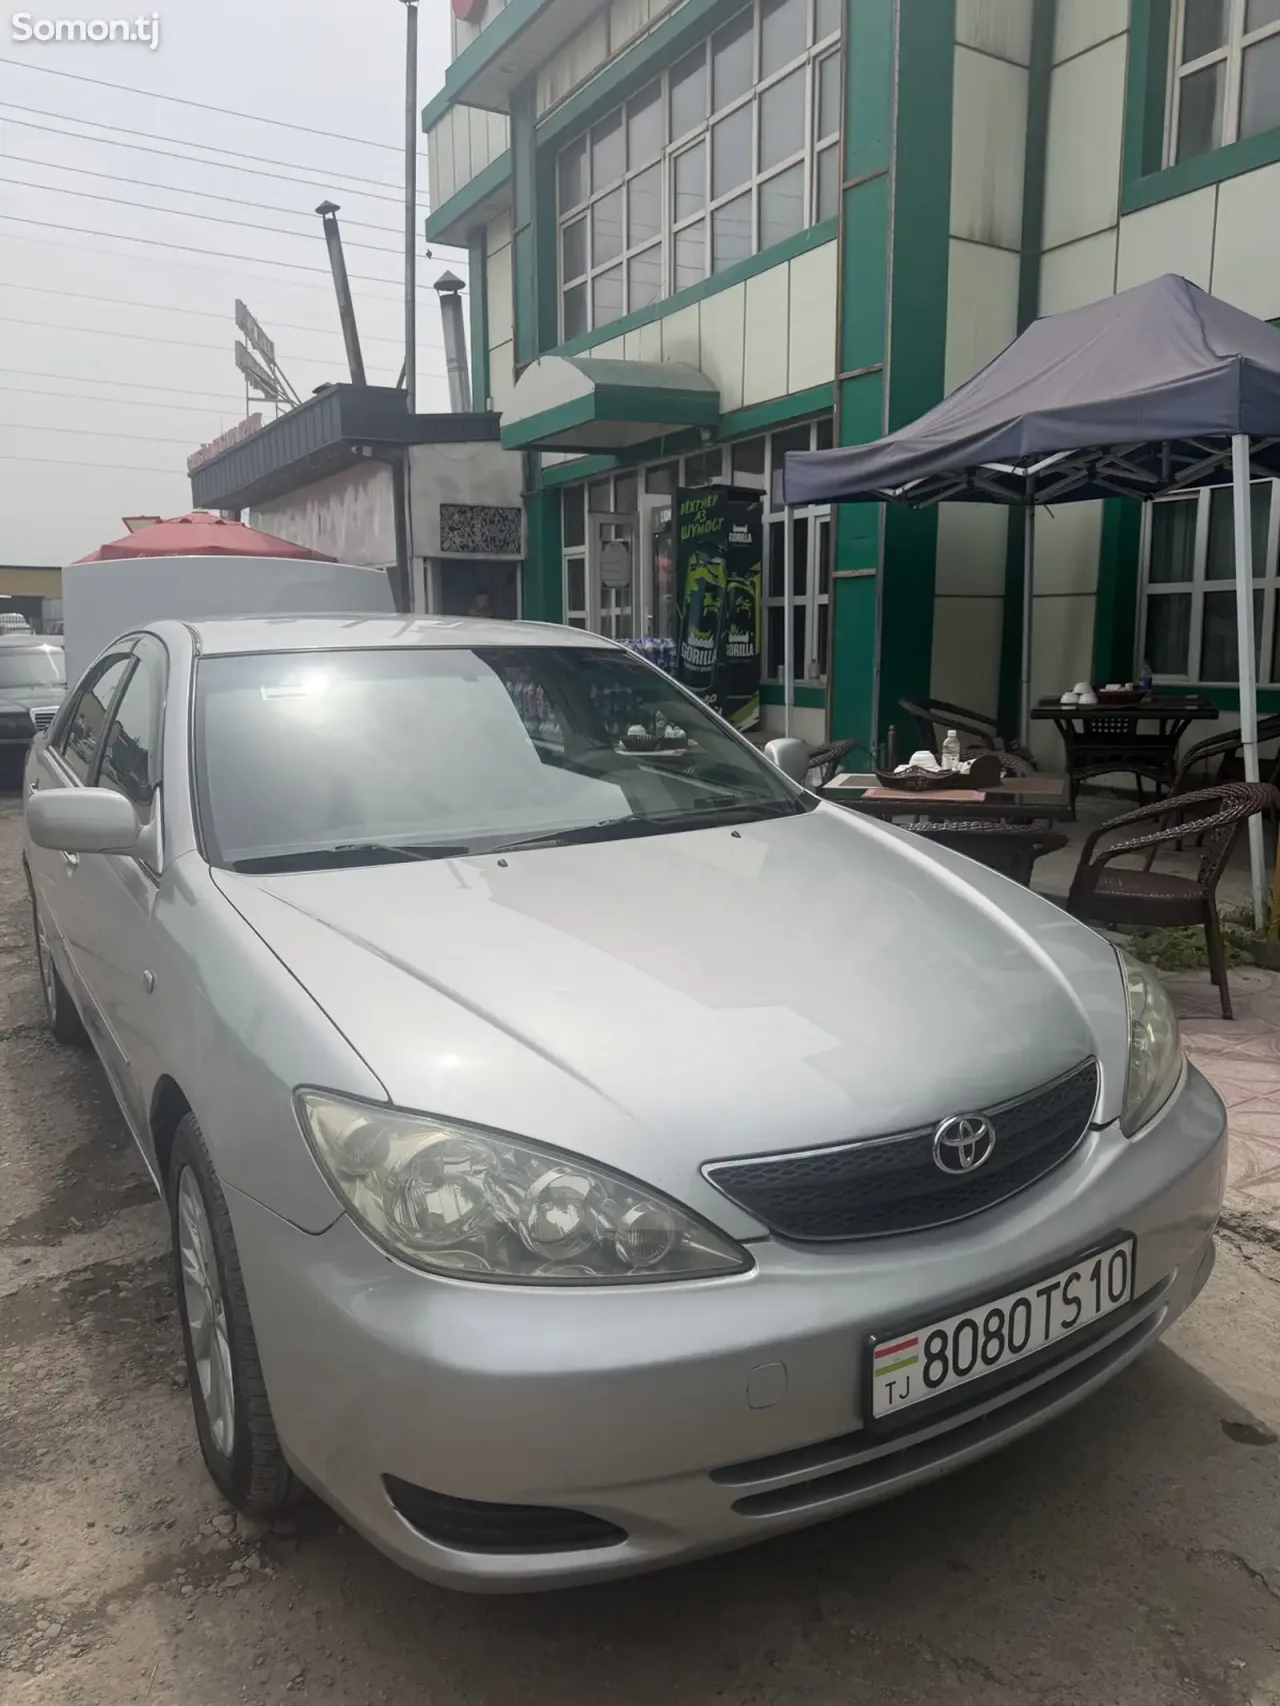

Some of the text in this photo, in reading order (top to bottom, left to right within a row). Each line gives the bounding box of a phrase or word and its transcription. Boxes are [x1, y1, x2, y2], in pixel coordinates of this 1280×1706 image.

[681, 518, 725, 541] ШУМОСТ
[681, 642, 717, 665] GORILLA
[885, 1376, 910, 1404] TJ
